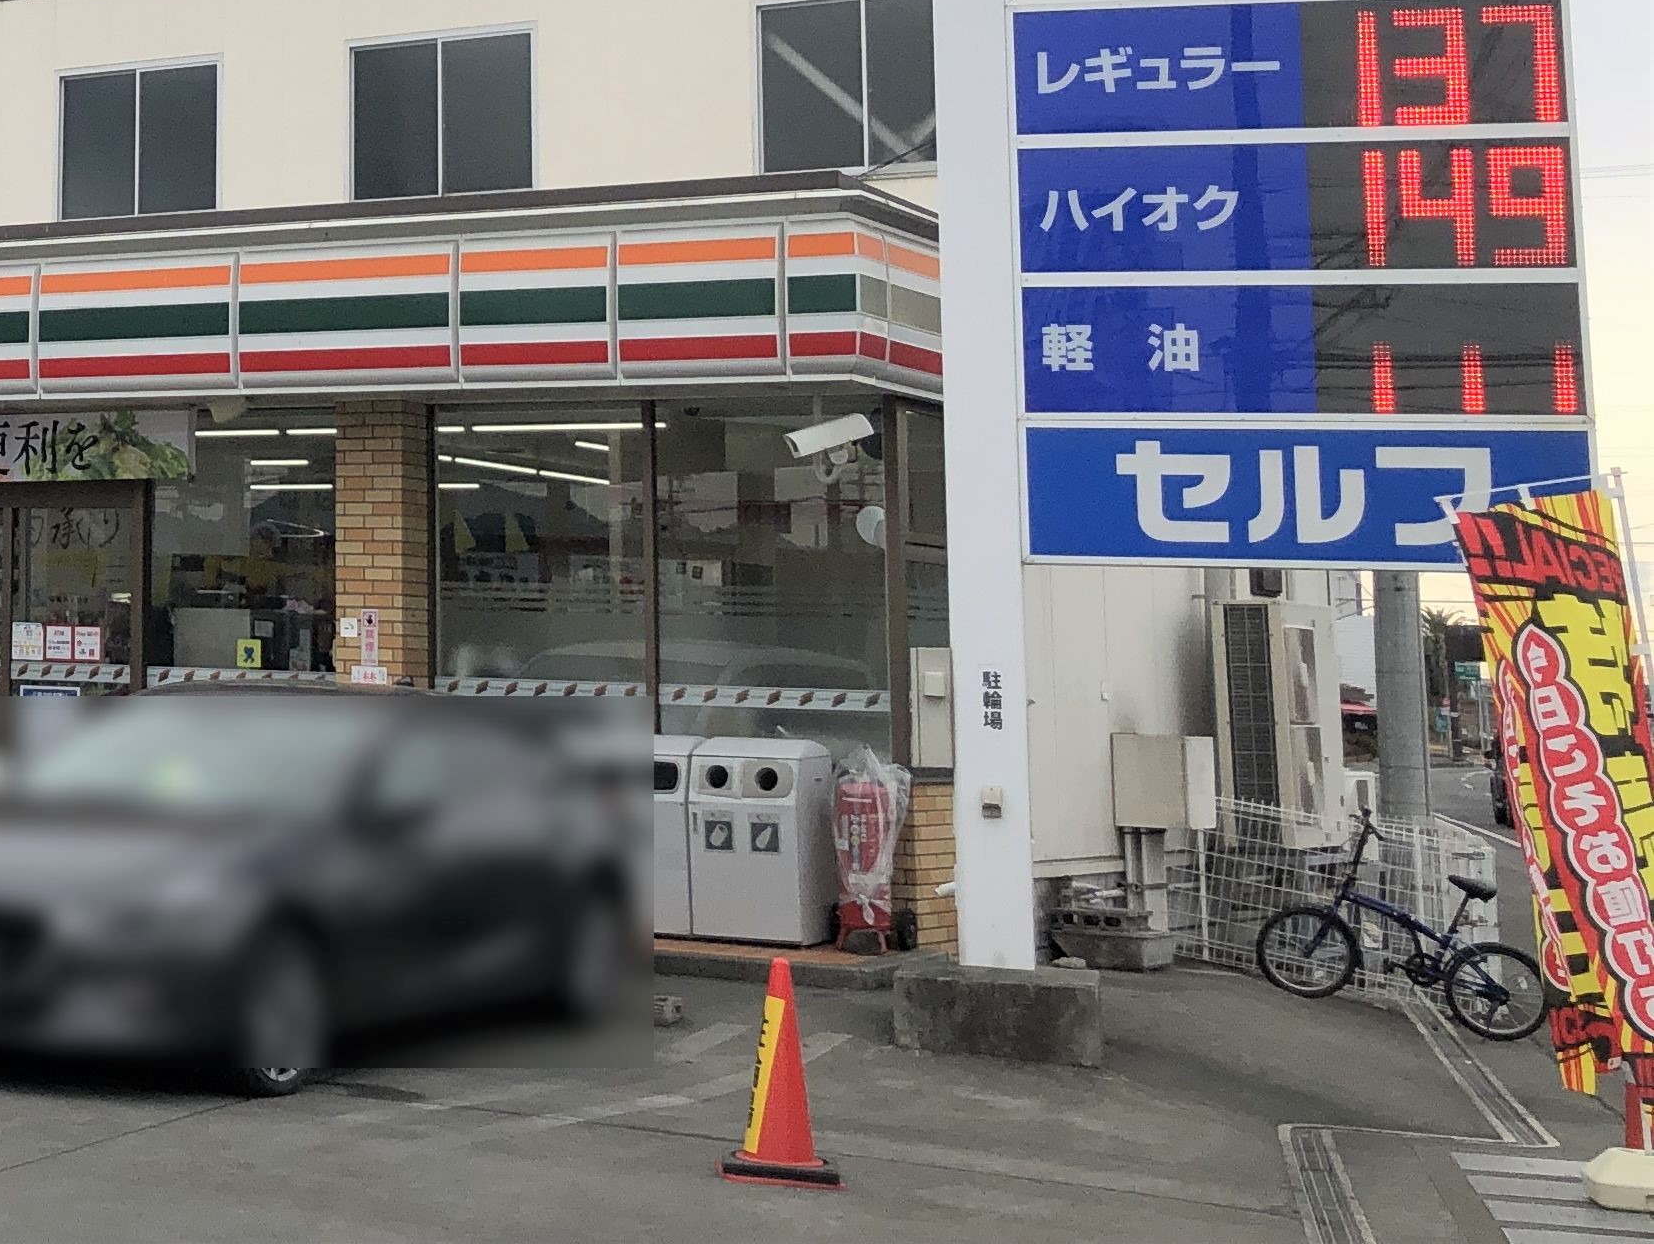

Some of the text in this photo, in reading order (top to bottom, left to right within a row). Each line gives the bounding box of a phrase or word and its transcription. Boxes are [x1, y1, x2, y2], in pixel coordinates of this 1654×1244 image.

[1035, 5, 1561, 126] レギュラー 137
[1040, 146, 1567, 266] ハイオク 149
[1116, 440, 1492, 545] セルフ
[982, 671, 1002, 730] 駐輪場
